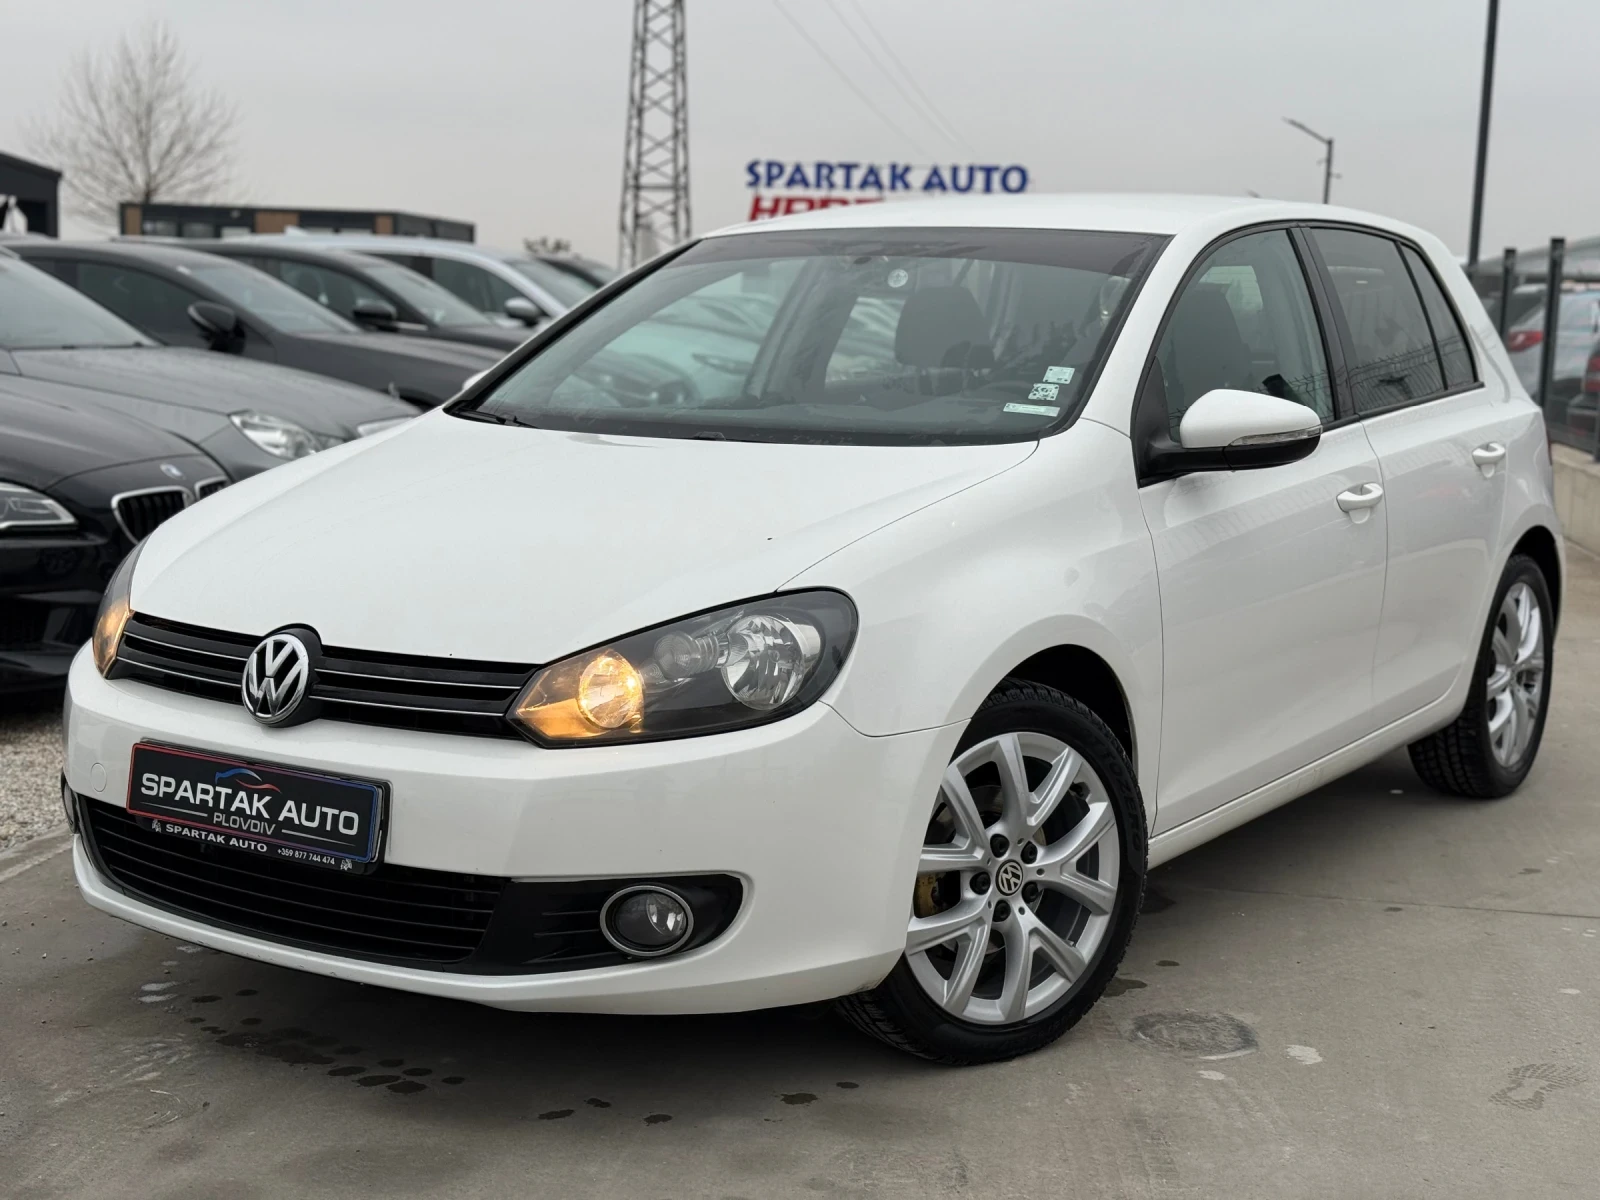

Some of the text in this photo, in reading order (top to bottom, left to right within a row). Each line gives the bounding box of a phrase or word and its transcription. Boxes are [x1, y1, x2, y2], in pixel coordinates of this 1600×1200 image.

[746, 160, 1028, 193] SPARTAK AUTO
[141, 773, 359, 836] SPARTAK AUTO
[213, 812, 276, 835] PLOVDIV
[165, 824, 335, 865] SPARTAK AUTO +359 877 744 474
